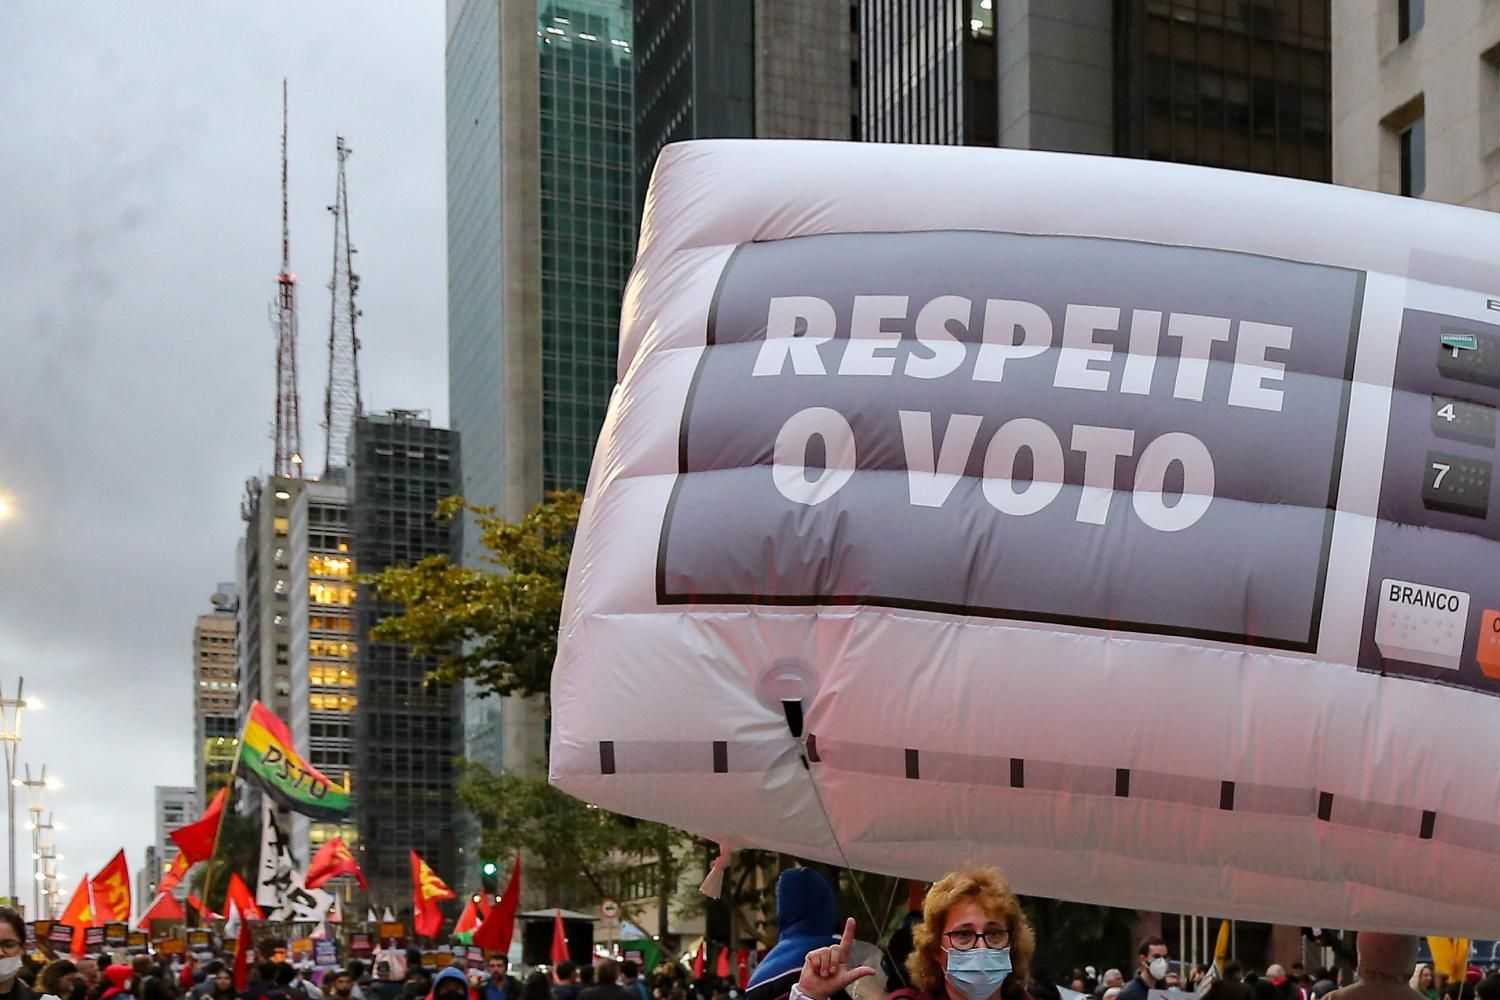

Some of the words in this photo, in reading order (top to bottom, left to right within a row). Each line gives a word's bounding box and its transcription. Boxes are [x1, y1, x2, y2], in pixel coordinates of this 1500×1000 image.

[752, 295, 1294, 412] RESPEITE
[1437, 403, 1456, 423] 4
[772, 407, 857, 506] O
[899, 409, 1215, 532] VOTO
[1432, 462, 1451, 489] 7
[1389, 584, 1460, 612] BRANCO
[262, 744, 327, 799] PSTU
